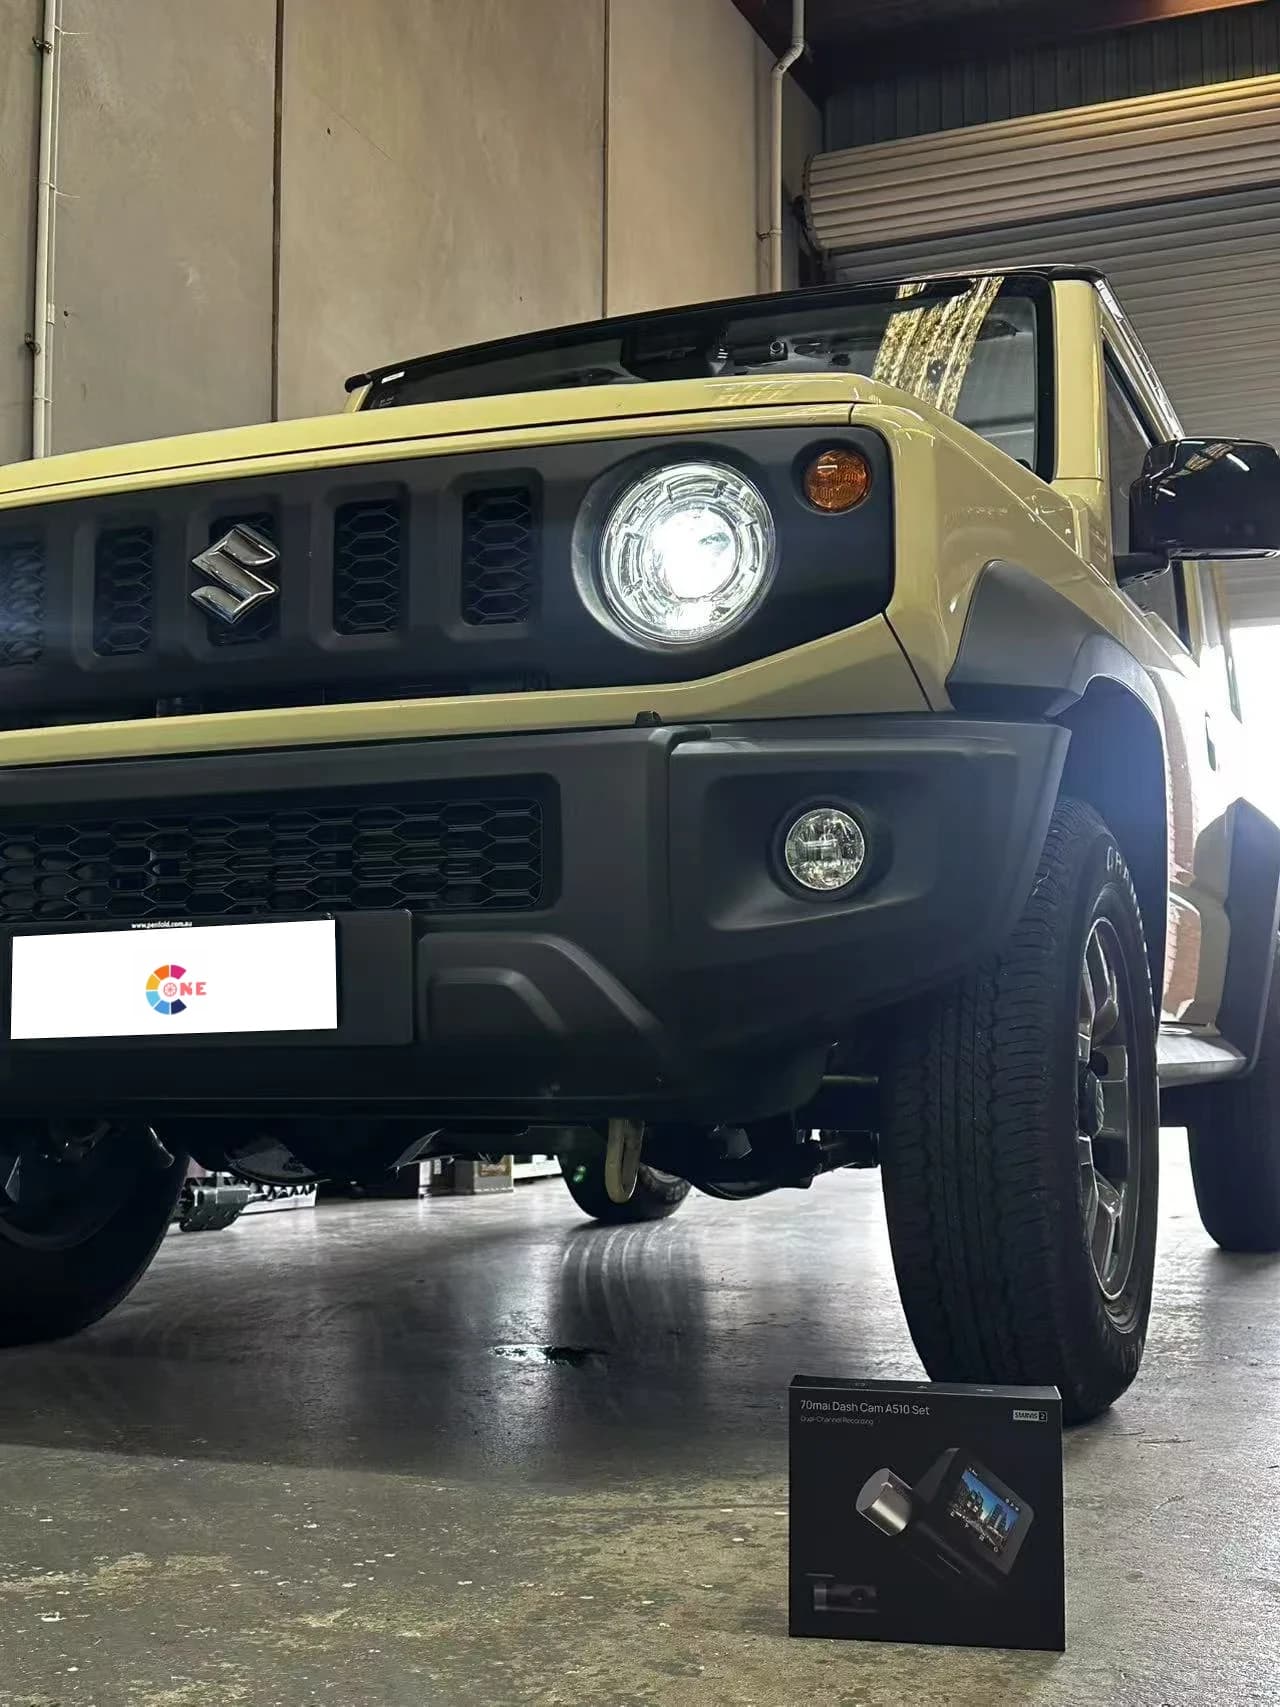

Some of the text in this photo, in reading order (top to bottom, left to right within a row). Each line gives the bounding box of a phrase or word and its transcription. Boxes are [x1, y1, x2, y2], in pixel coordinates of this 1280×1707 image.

[800, 1399, 930, 1416] 70mai Dash Cam A510 Set
